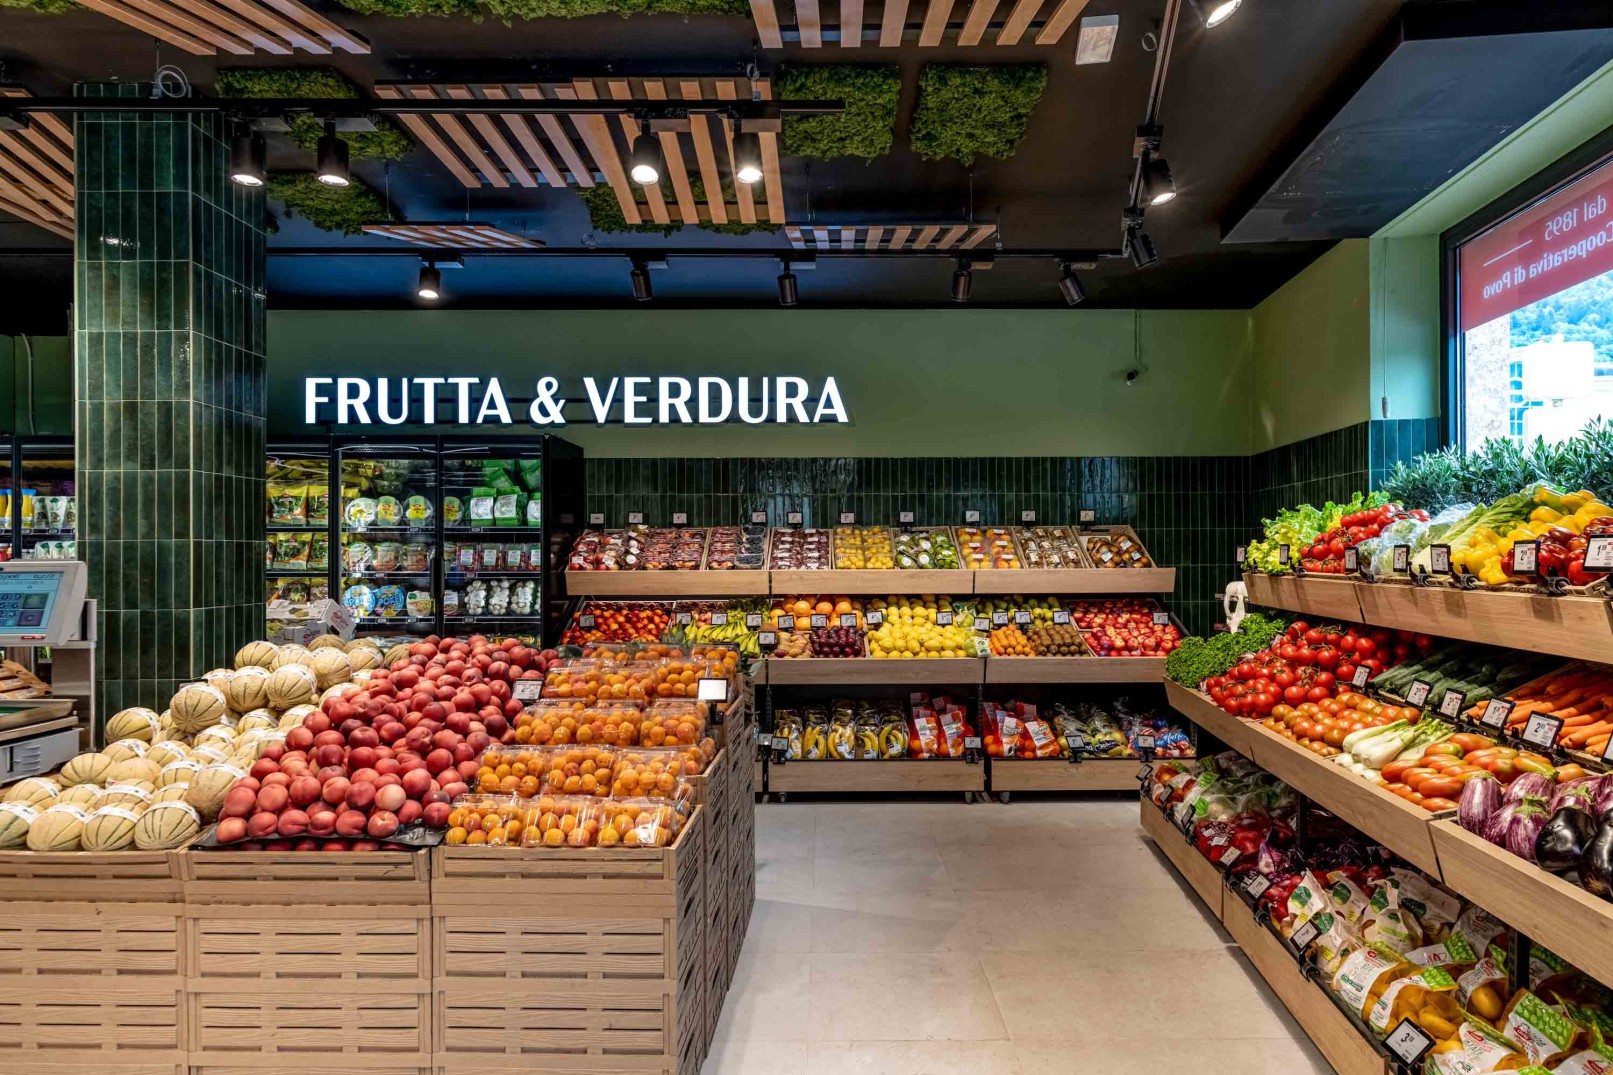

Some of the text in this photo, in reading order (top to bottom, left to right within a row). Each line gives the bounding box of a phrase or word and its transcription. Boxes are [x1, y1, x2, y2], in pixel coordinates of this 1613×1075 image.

[305, 376, 849, 425] FRUTTA & VERDURA
